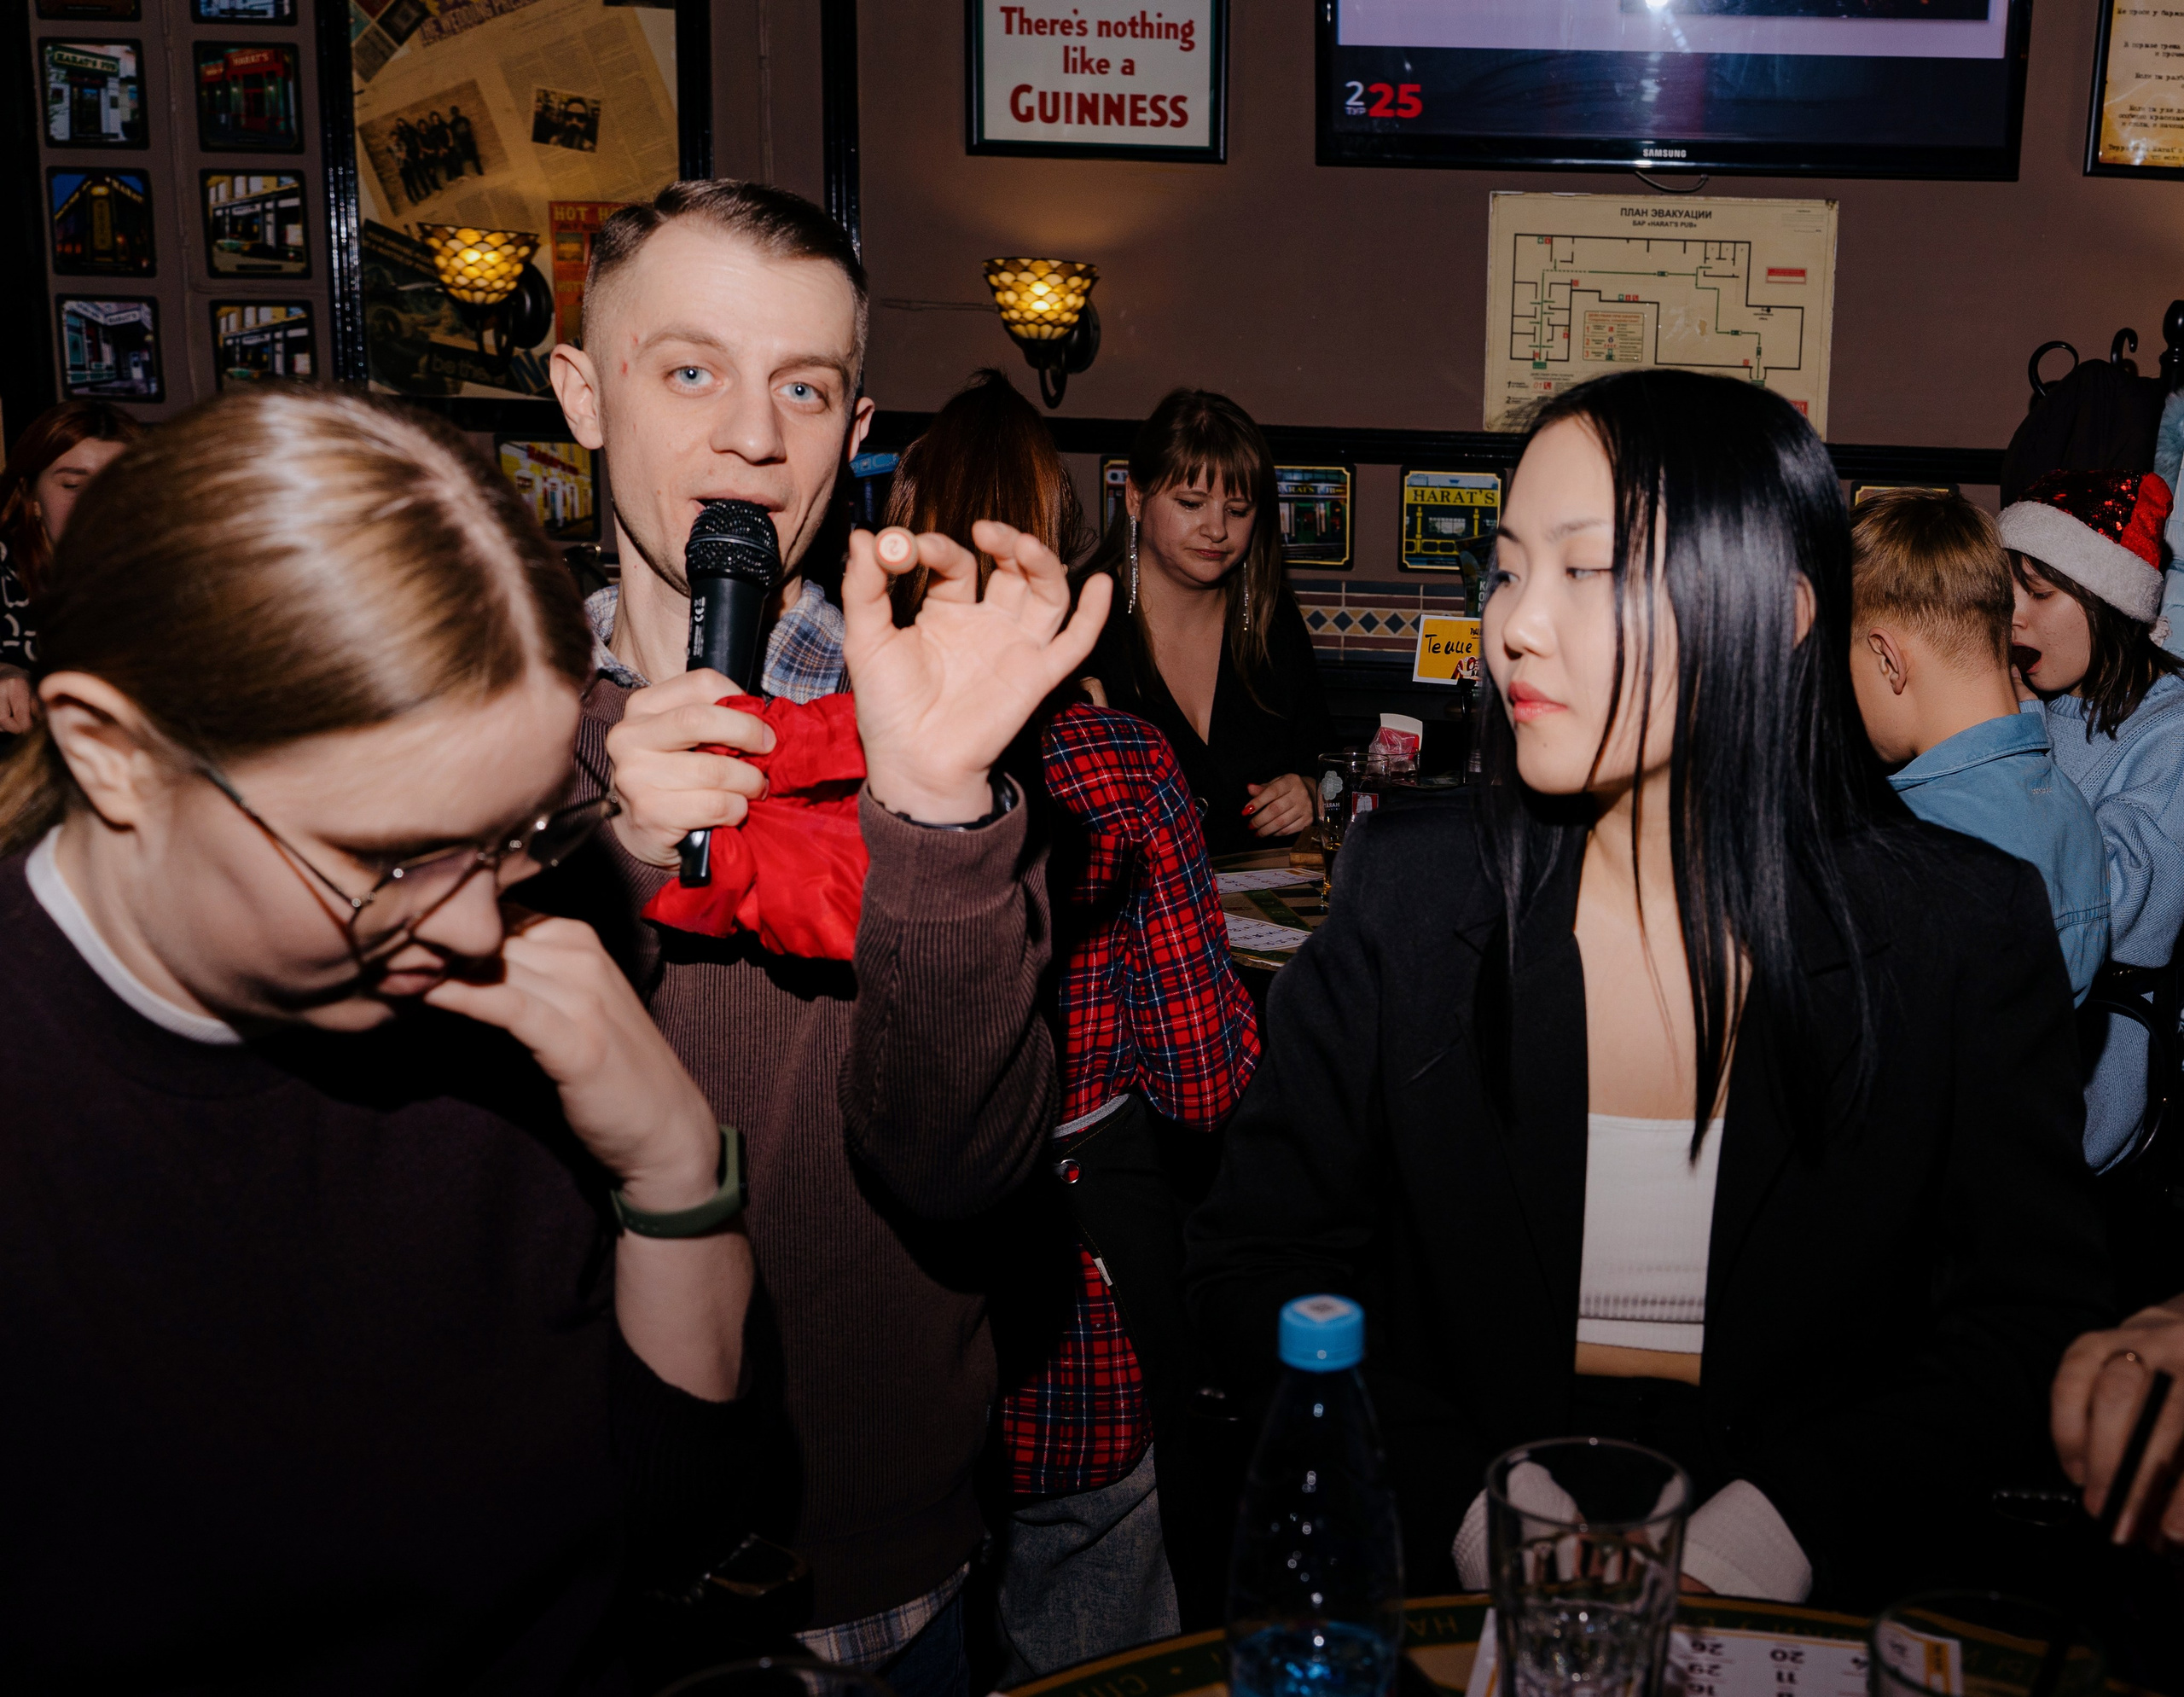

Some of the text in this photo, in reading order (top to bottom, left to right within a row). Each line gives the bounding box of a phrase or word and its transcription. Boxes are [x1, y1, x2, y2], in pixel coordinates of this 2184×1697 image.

[1000, 7, 1195, 51] There's nothing
[1063, 45, 1135, 76] like a
[1345, 80, 1365, 107] 2
[1367, 82, 1424, 119] 25
[1010, 84, 1188, 128] GUINNESS
[1642, 148, 1687, 158] SAMSUNG
[554, 205, 589, 222] HOT
[1620, 207, 1712, 220] ПЛАН ЭВАКУАЦИИ
[1413, 489, 1496, 505] HARAT'S
[1770, 1648, 1805, 1664] 20
[1776, 1671, 1797, 1685] 11
